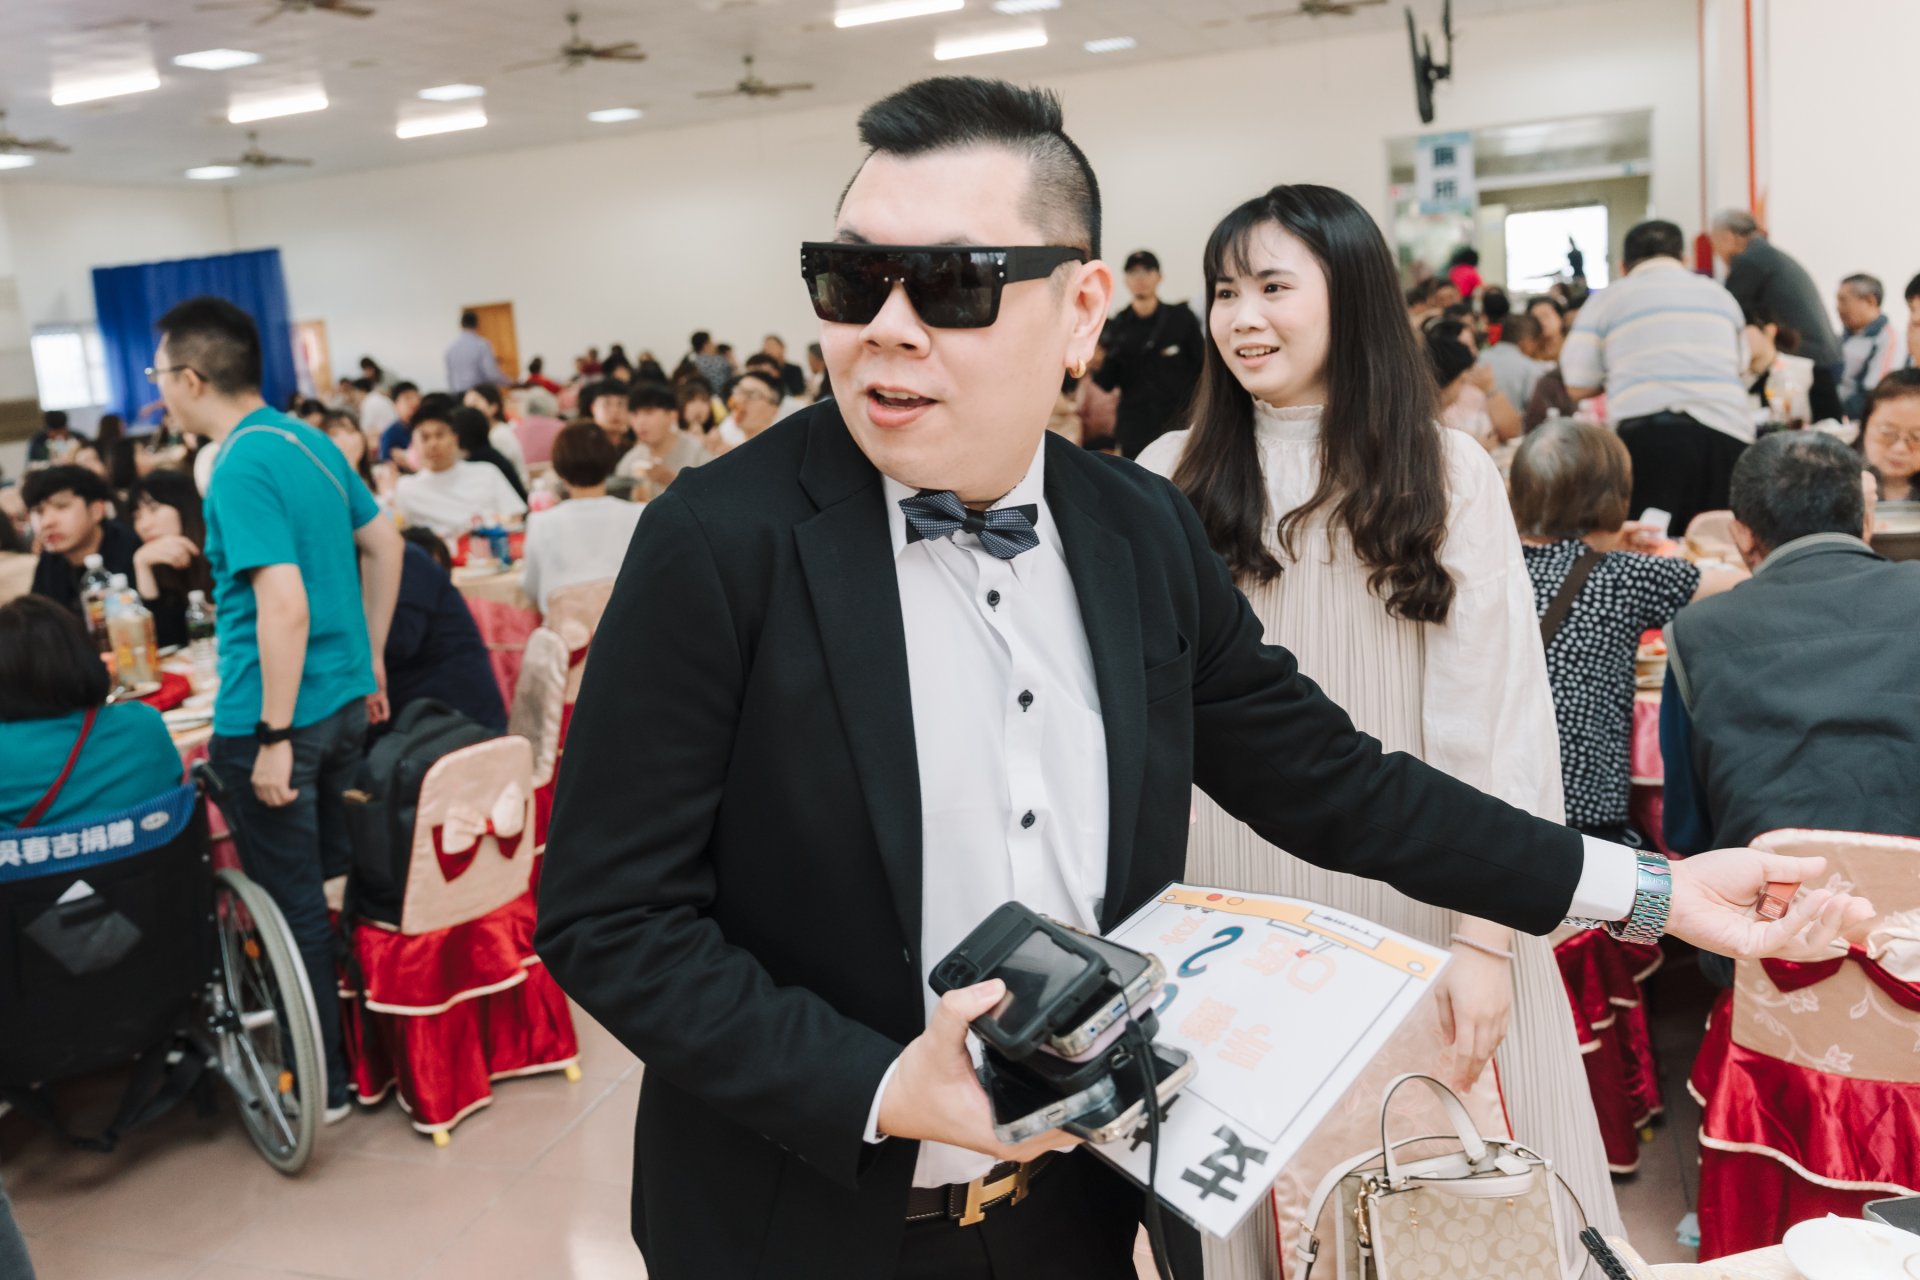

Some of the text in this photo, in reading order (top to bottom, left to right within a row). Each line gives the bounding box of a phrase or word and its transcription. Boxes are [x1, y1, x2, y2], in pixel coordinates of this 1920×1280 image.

[0, 818, 135, 867] 吳春吉捐贈
